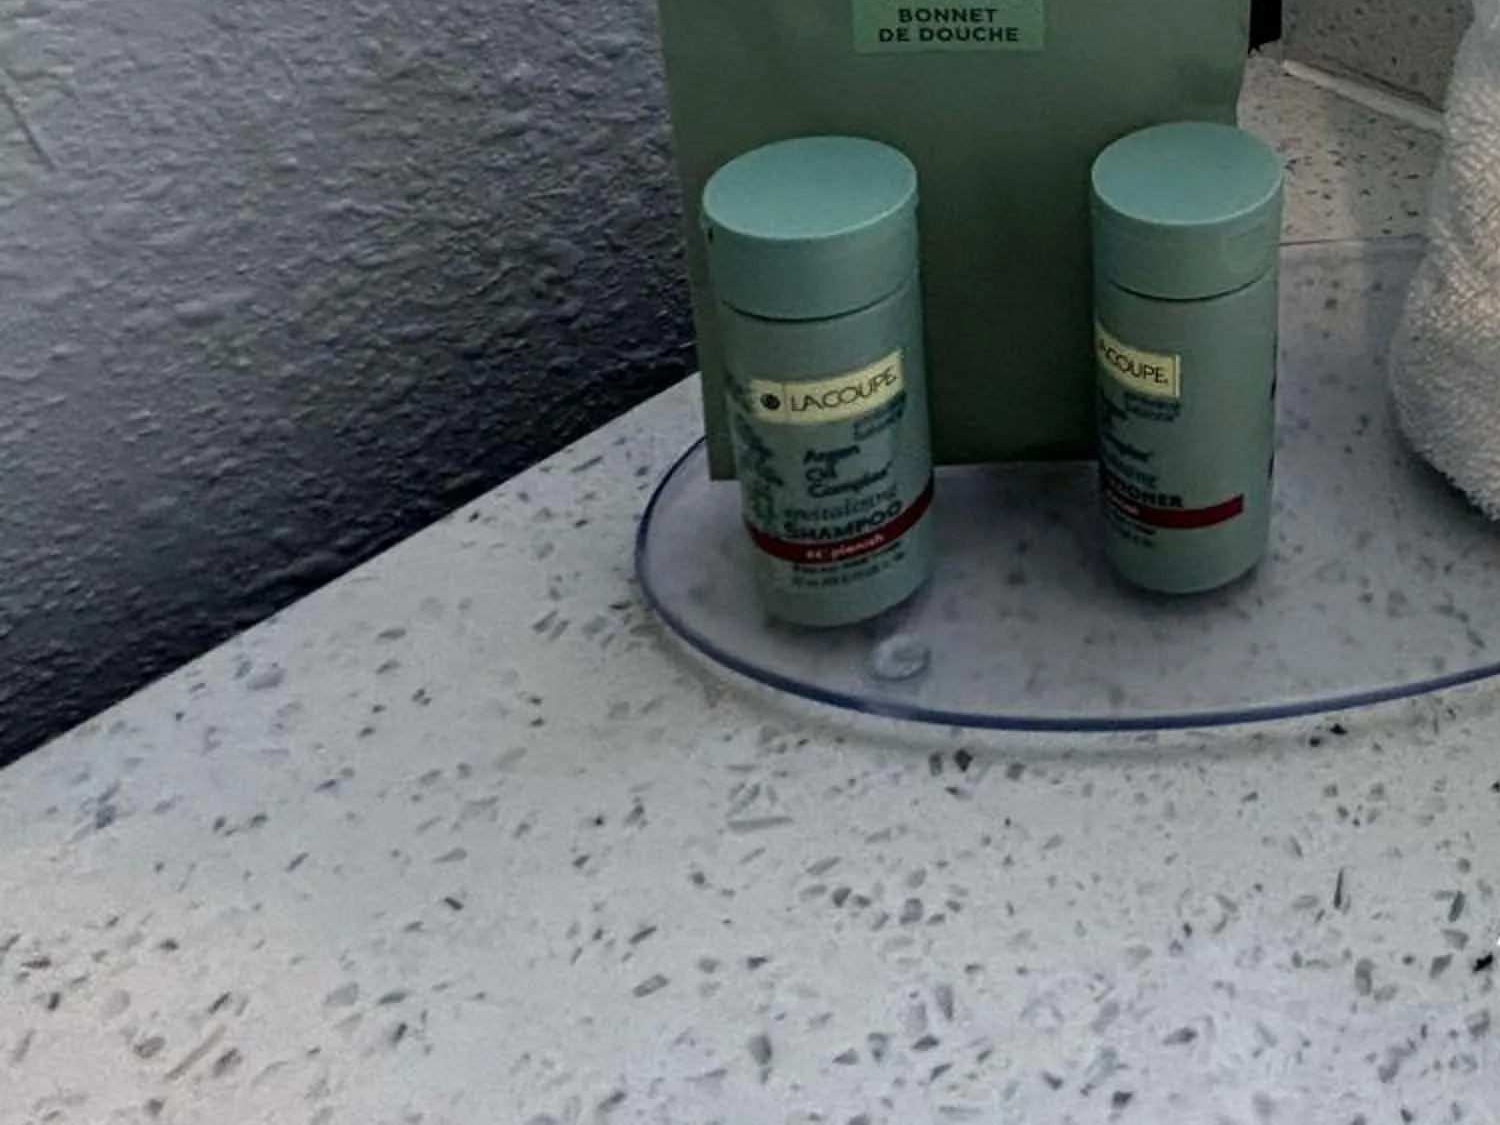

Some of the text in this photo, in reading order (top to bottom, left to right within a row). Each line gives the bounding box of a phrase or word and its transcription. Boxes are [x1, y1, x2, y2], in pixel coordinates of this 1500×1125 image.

[898, 8, 998, 23] BONNET
[879, 27, 1019, 42] DE DOUCHE
[791, 364, 897, 412] LACOUPE
